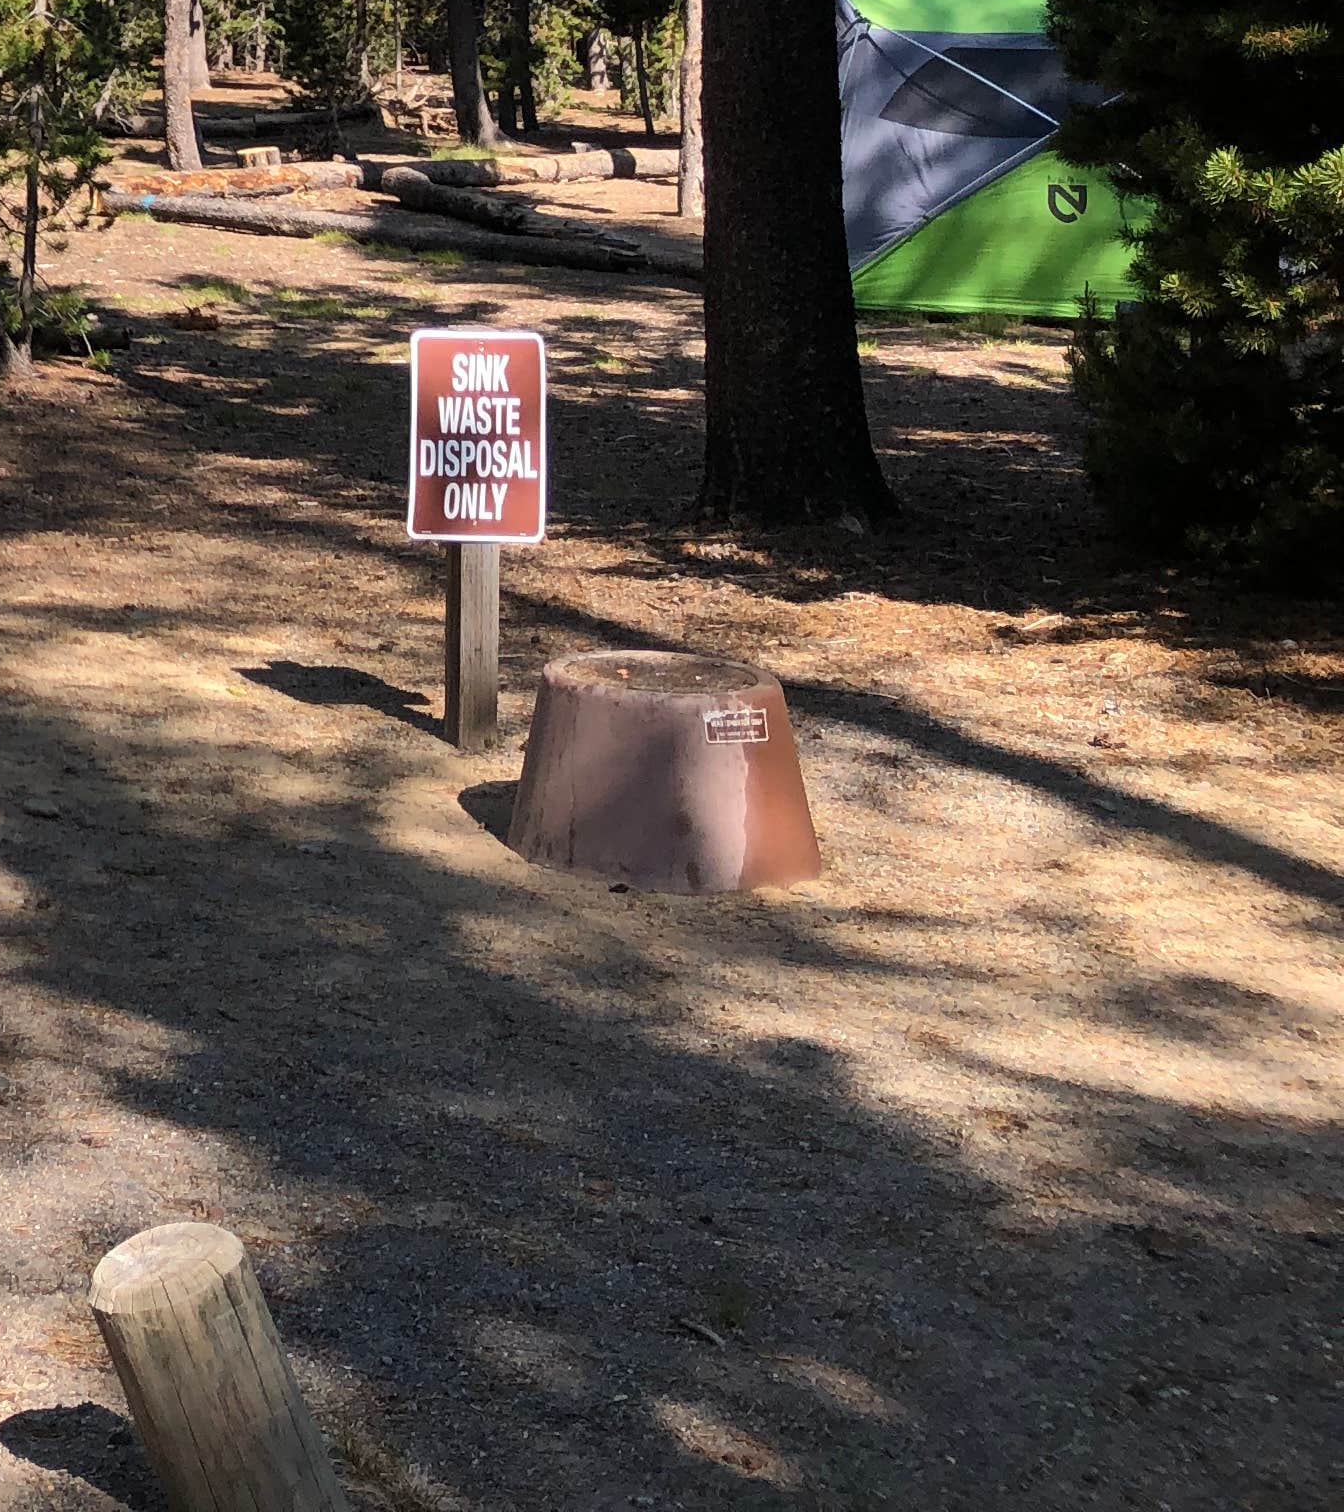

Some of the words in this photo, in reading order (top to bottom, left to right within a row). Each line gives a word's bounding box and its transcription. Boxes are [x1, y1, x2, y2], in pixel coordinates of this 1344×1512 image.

[452, 353, 509, 392] SINK
[438, 396, 520, 435] WASTE
[420, 439, 538, 479] DISPOSAL
[443, 482, 508, 521] ONLY
